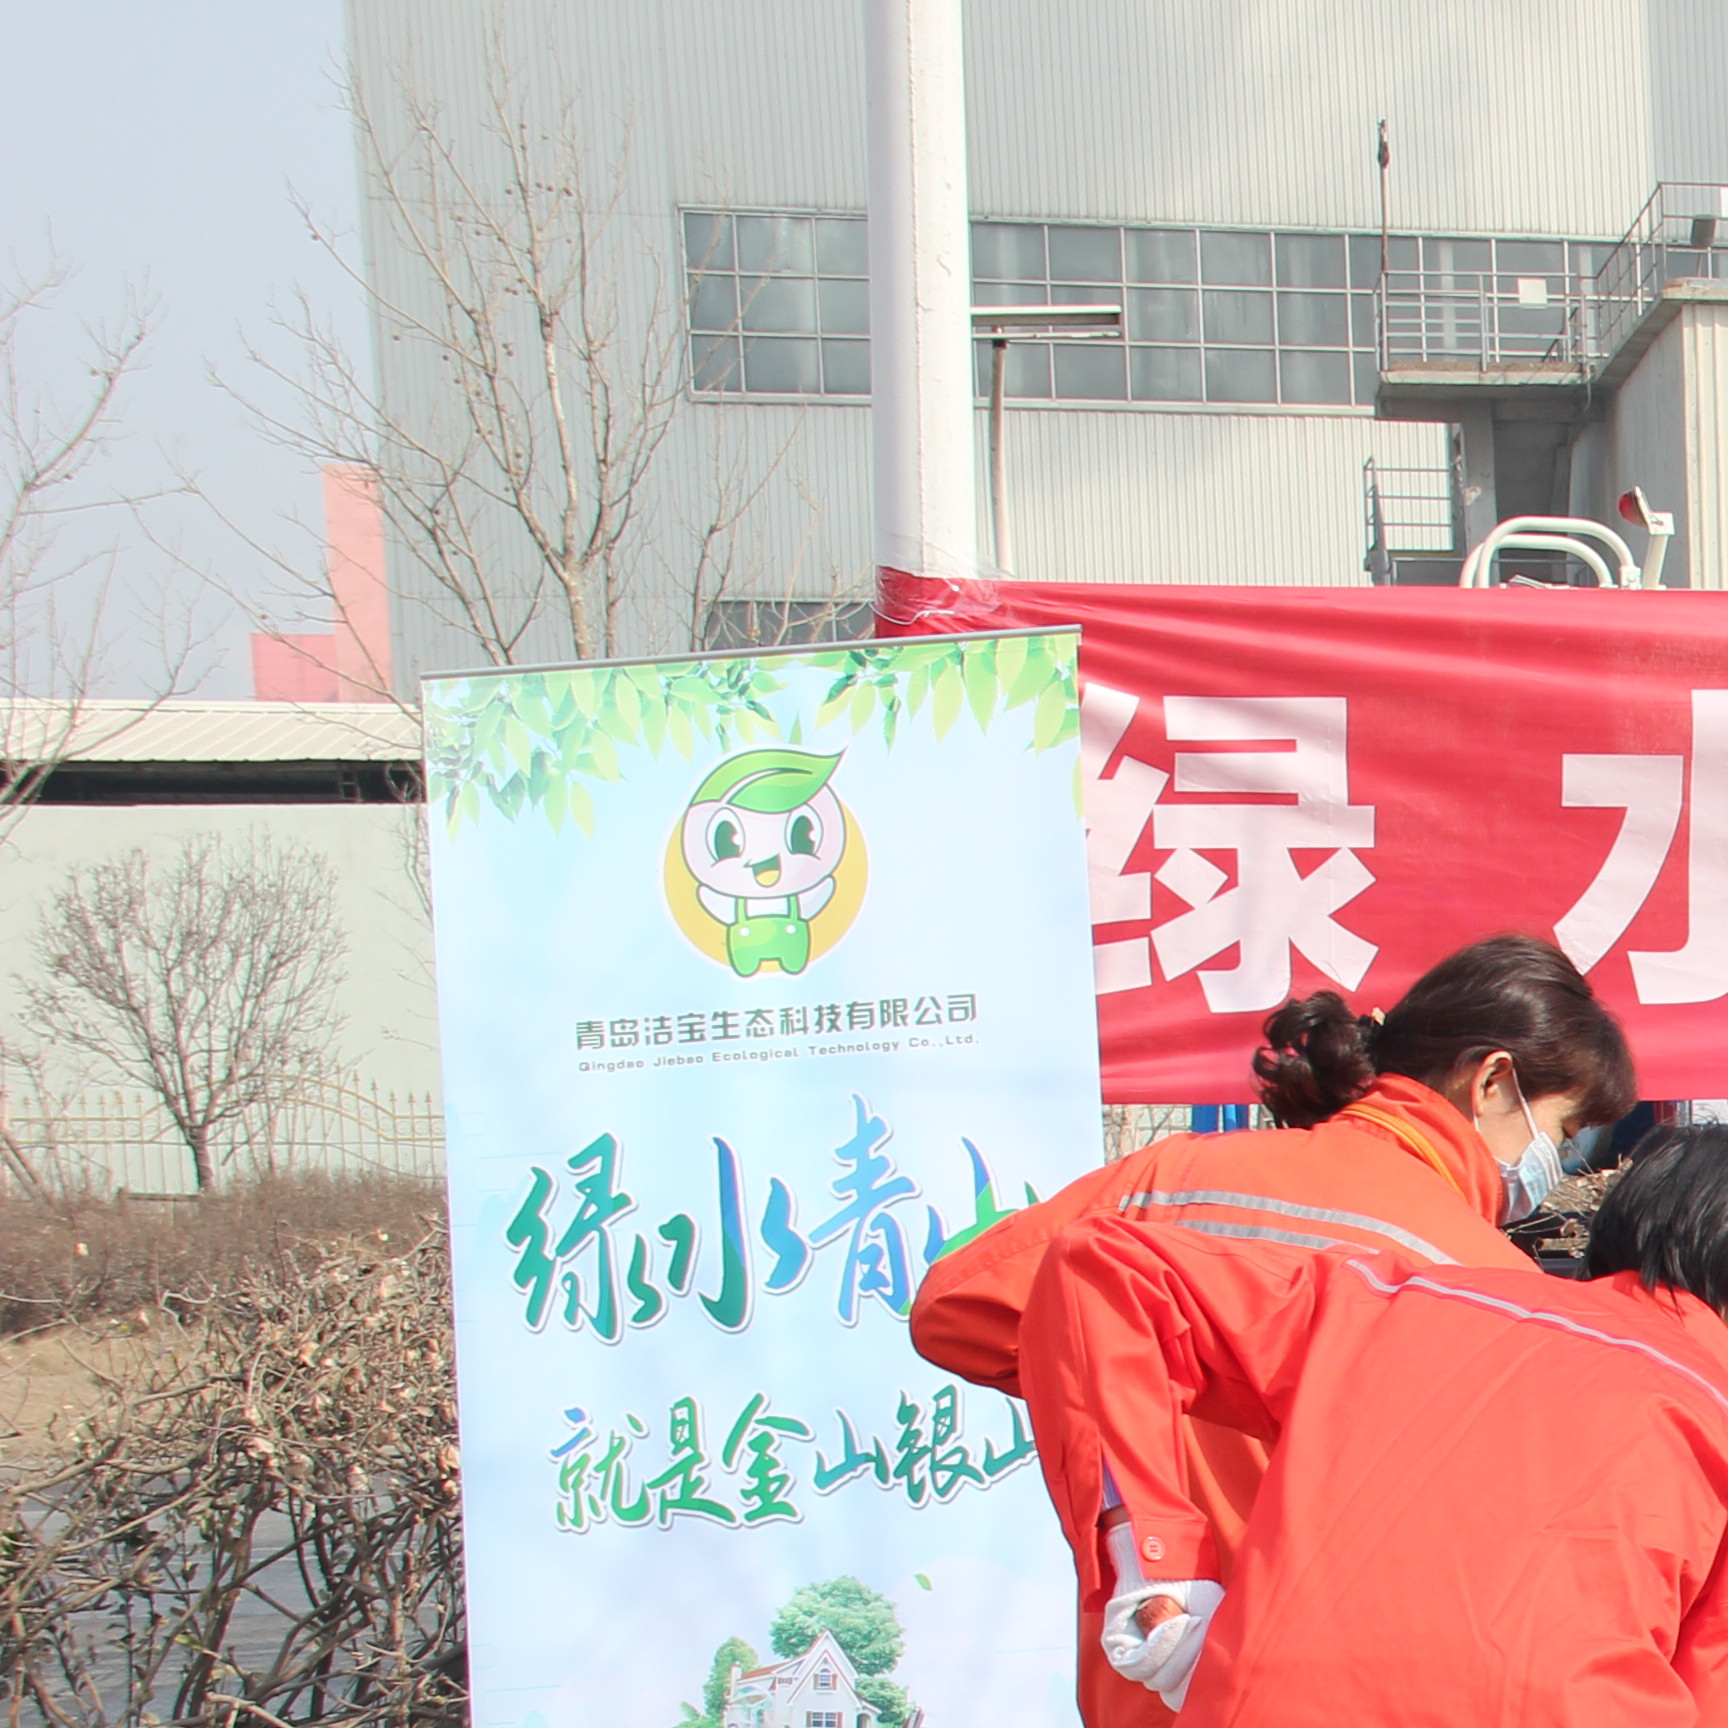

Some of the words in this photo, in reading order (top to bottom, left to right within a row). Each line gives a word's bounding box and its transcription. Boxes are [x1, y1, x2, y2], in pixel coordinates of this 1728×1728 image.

[575, 993, 978, 1050] 青岛洁宝生态科技有限公司
[578, 1060, 645, 1073] Qingdao
[653, 1055, 704, 1068] Jiebao
[712, 1048, 799, 1063] Ecological
[808, 1040, 901, 1057] Technology
[505, 1093, 1042, 1341] 绿水青山
[550, 1383, 1037, 1530] 就是金山银山
